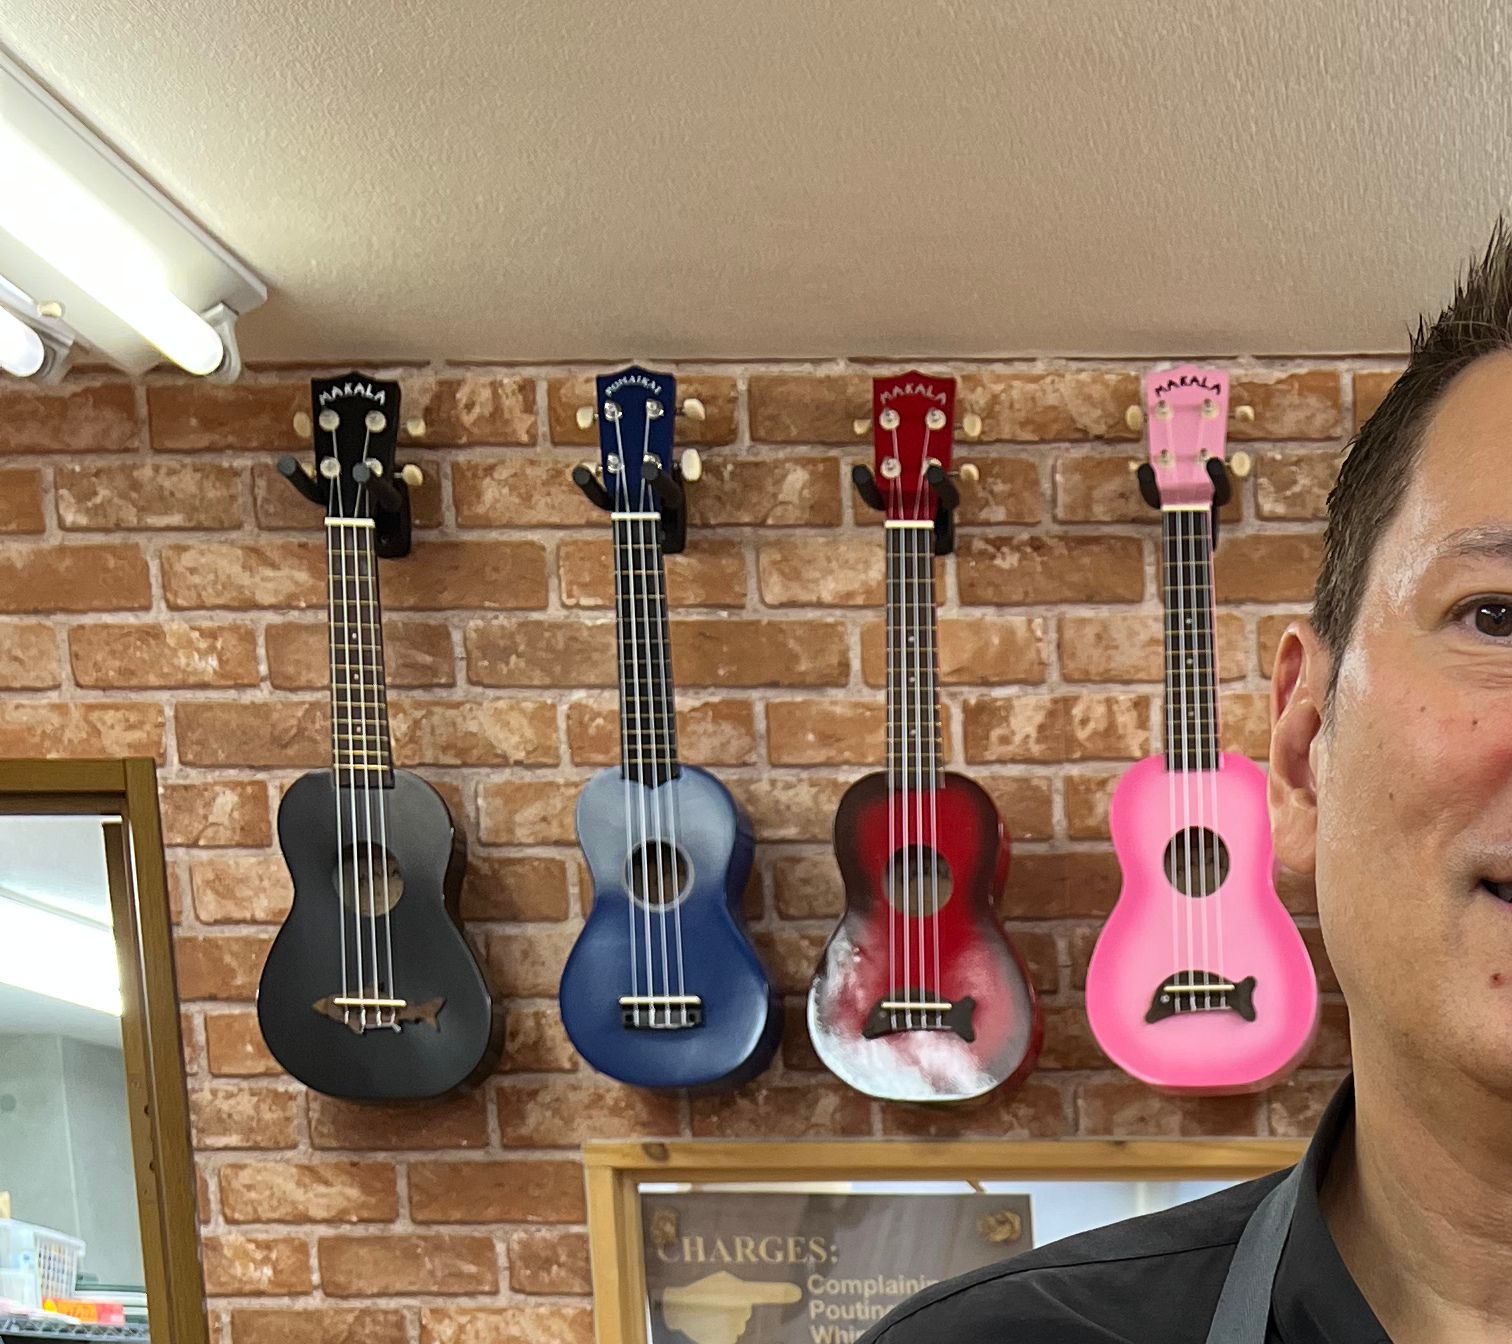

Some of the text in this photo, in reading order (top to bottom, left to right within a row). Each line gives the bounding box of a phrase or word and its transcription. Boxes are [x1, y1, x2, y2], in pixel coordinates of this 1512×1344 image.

[318, 382, 386, 406] MAKALA
[880, 383, 947, 406] MAKALA
[1154, 375, 1222, 398] MAKALA
